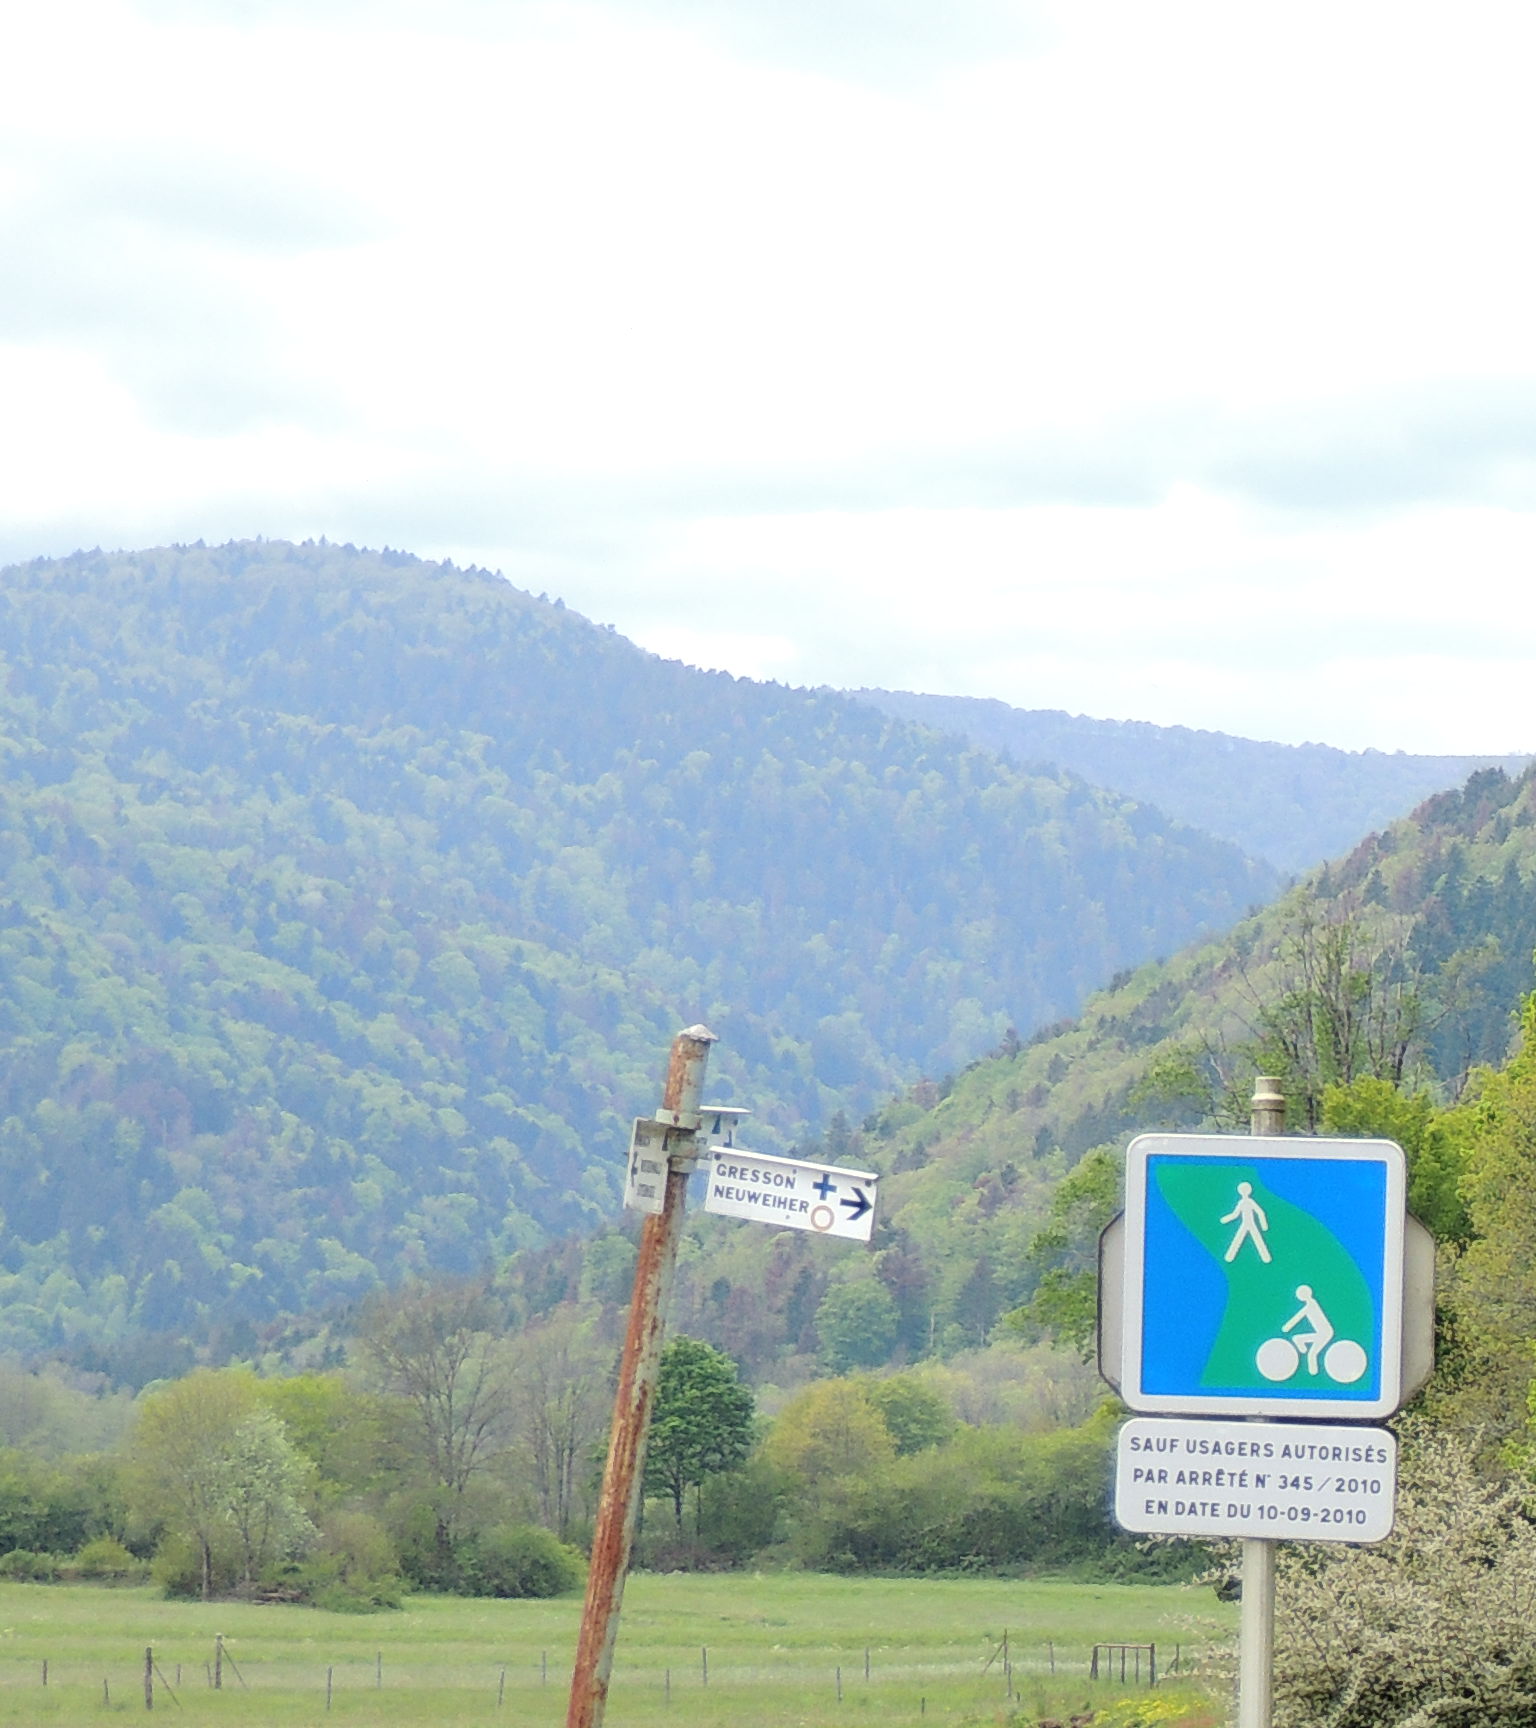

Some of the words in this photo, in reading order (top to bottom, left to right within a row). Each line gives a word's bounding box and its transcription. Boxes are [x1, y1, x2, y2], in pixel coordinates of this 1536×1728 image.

[716, 1163, 796, 1189] GRESSON
[713, 1184, 809, 1214] NEUWEIHER
[1130, 1437, 1180, 1452] SAUF
[1186, 1439, 1274, 1458] USAGERS
[1281, 1444, 1387, 1464] AUTORISÉS
[1133, 1468, 1168, 1484] PAR
[1176, 1469, 1248, 1488] ARRÊTÉ
[1145, 1500, 1168, 1514] EN
[1175, 1501, 1220, 1517] DATE
[1228, 1504, 1251, 1518] DU
[1258, 1505, 1366, 1525] 10-09-2010
